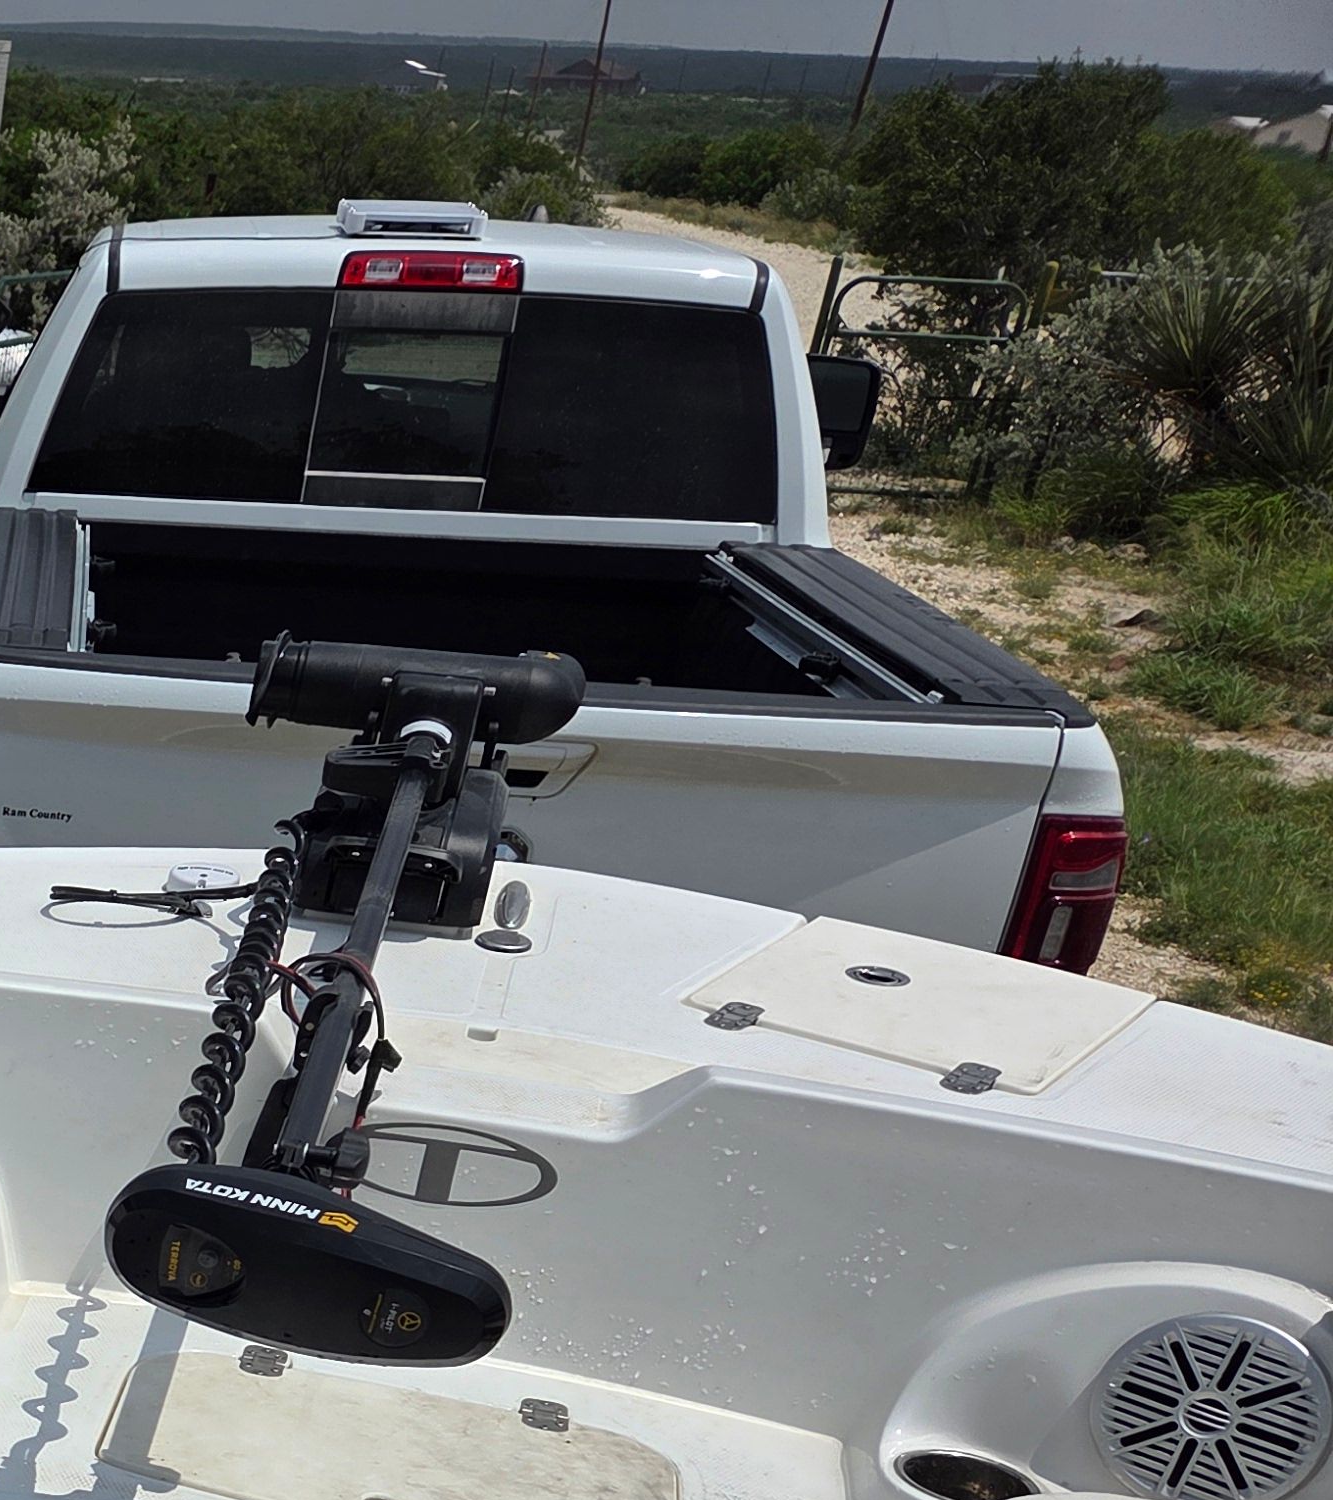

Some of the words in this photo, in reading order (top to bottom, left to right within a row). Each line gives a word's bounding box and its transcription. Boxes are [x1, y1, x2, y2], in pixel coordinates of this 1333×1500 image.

[2, 806, 27, 817] Ram
[29, 808, 72, 823] Country
[185, 1178, 251, 1201] KOTA
[249, 1193, 321, 1220] MINN
